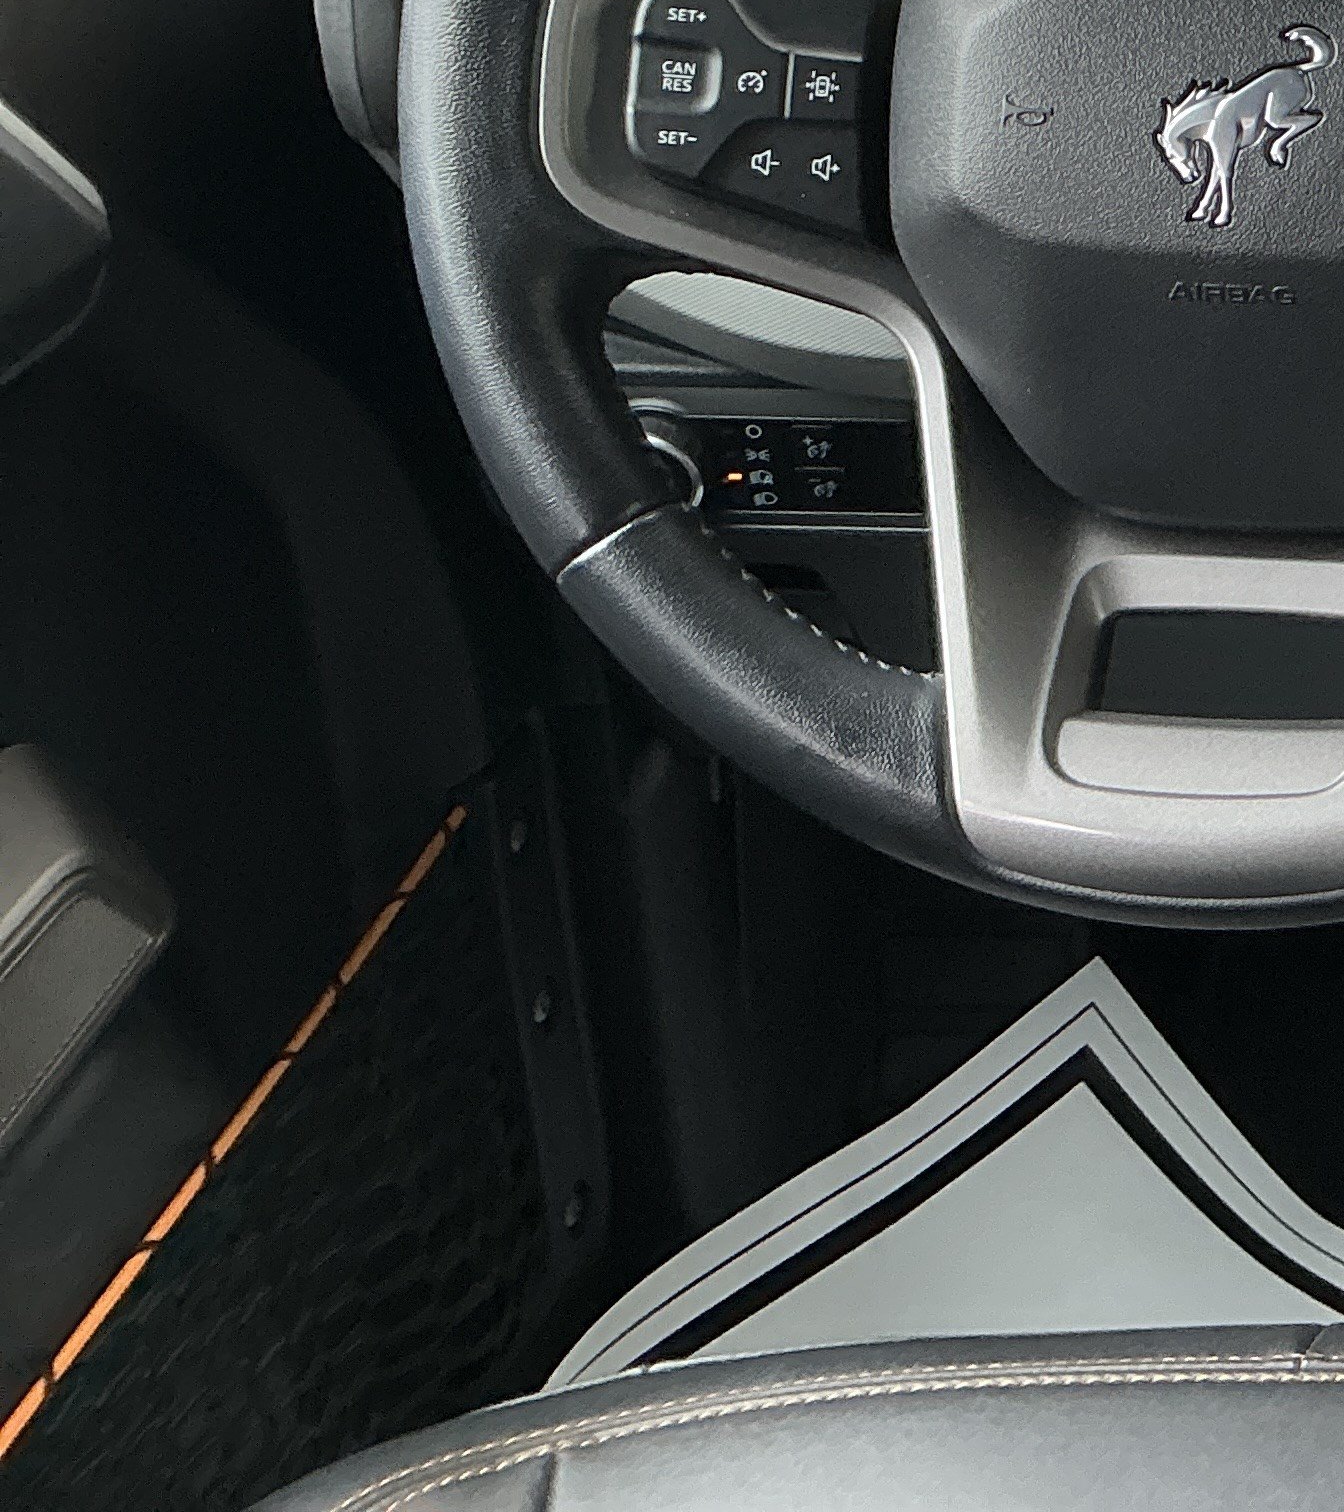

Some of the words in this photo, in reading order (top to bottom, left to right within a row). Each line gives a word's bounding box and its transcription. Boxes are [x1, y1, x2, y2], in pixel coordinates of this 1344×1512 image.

[667, 7, 707, 23] SET+
[662, 60, 697, 76] CAN
[662, 78, 693, 93] RES
